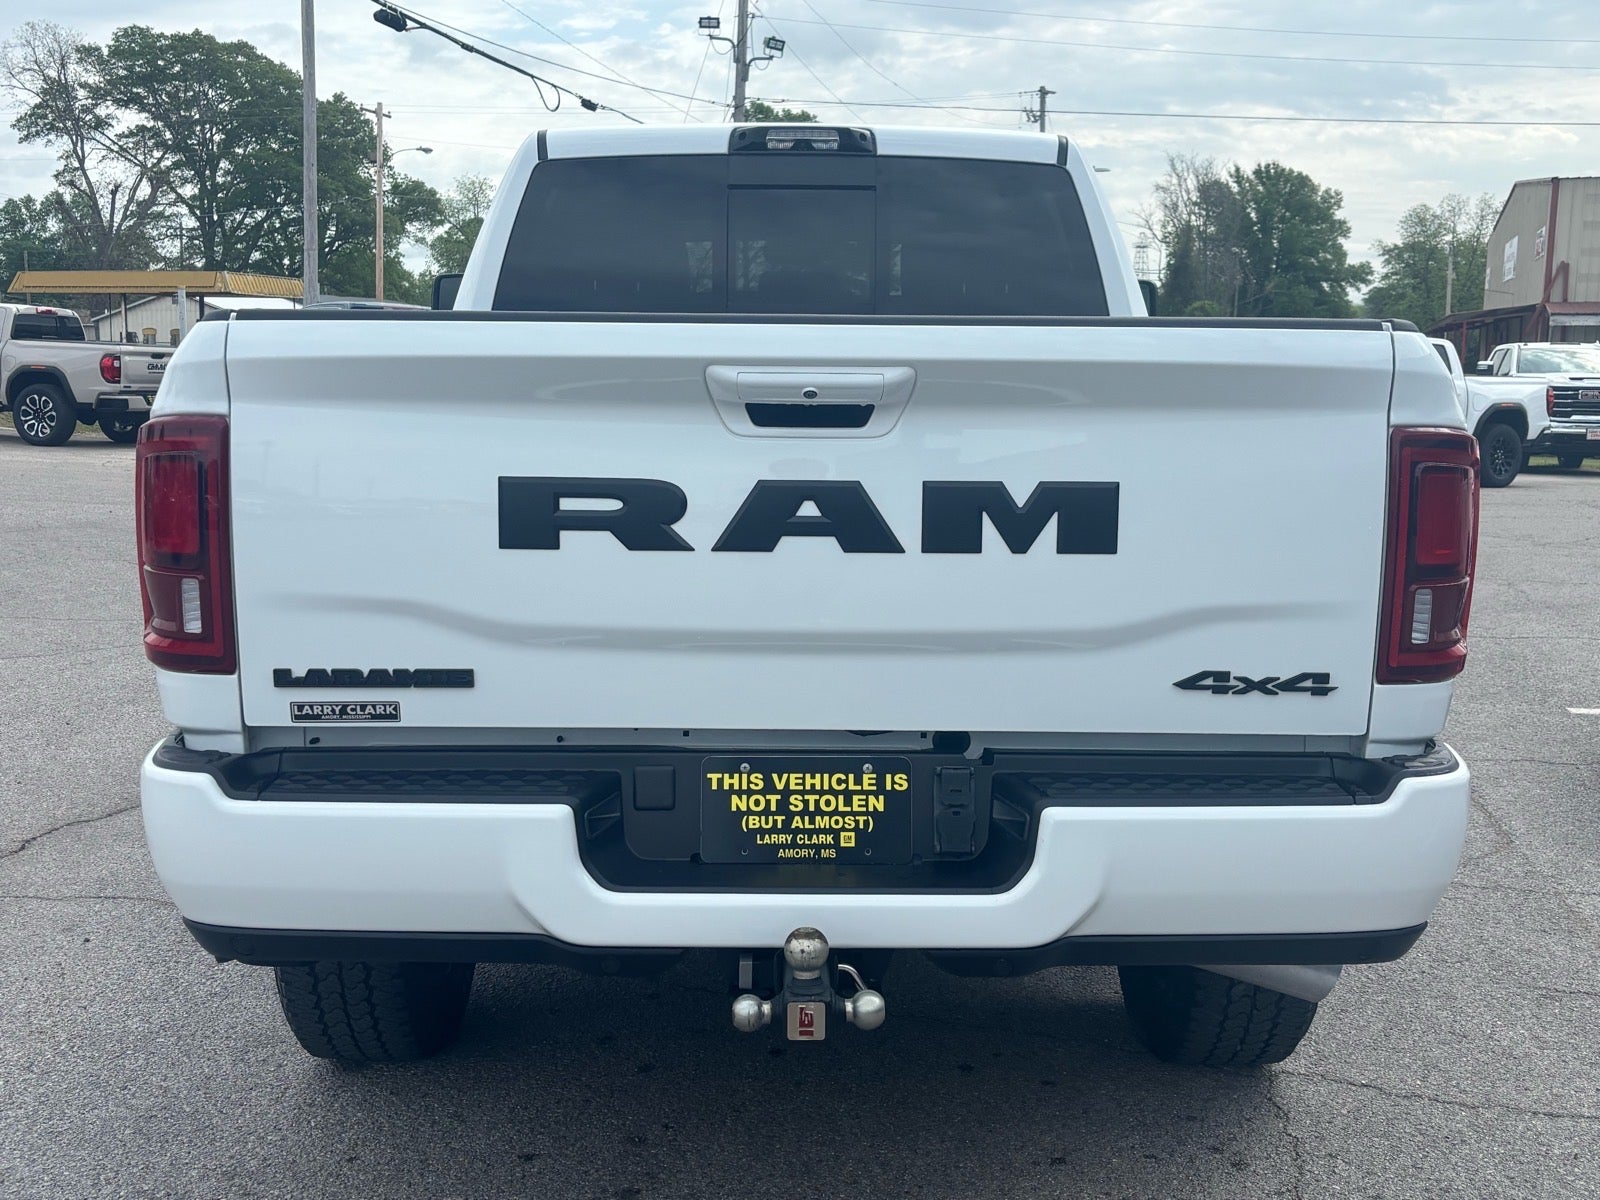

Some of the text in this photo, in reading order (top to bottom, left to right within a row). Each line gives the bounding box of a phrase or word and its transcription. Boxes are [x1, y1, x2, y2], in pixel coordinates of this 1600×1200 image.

[498, 476, 1120, 554] RAM
[1172, 670, 1339, 696] 4x4
[294, 705, 397, 715] LARRY CLARK
[707, 773, 909, 791] THIS VEHICLE IS
[731, 795, 885, 812] NOT STOLEN
[741, 815, 874, 832] (BUT ALMOST)
[756, 834, 793, 844] LARRY
[796, 834, 834, 844] CLARK
[778, 848, 836, 859] AMORY, MS
